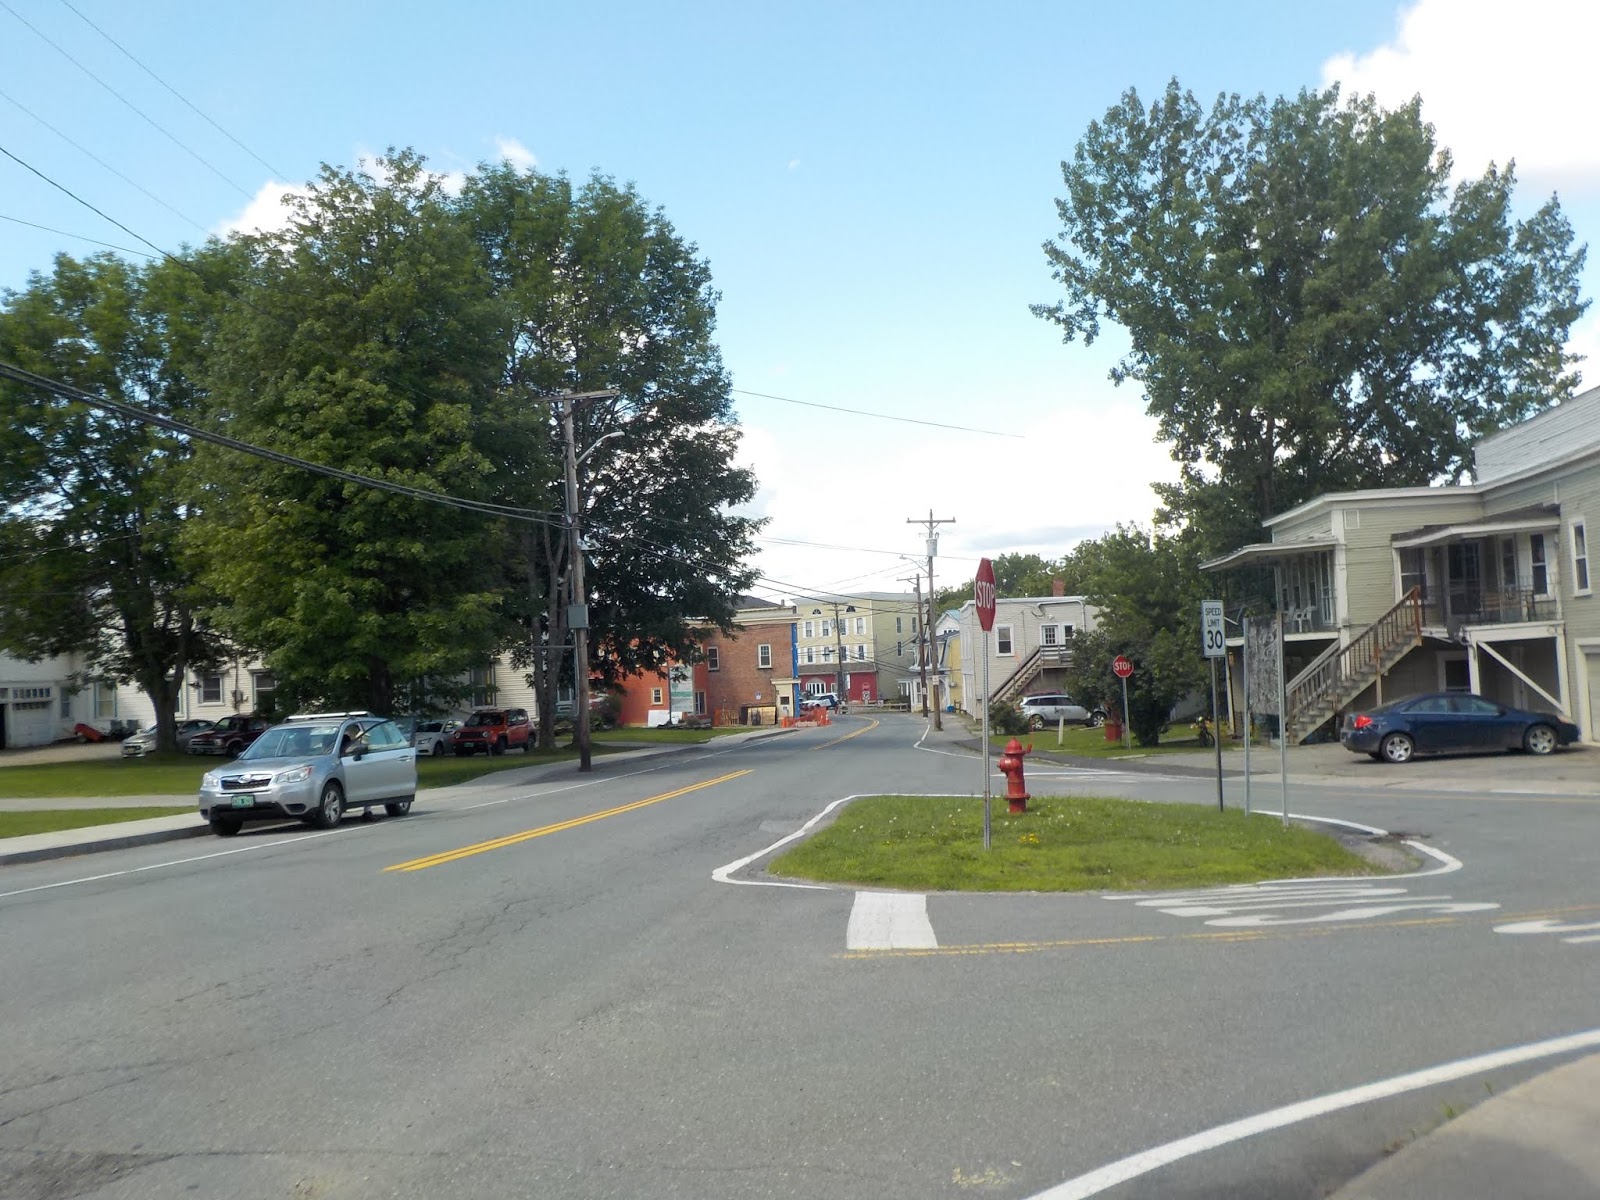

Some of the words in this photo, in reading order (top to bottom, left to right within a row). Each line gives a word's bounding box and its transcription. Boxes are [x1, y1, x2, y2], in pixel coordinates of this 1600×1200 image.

[976, 581, 995, 609] STOP
[1205, 607, 1222, 616] SPEED
[1207, 618, 1220, 627] LIMIT
[1207, 629, 1223, 649] 30
